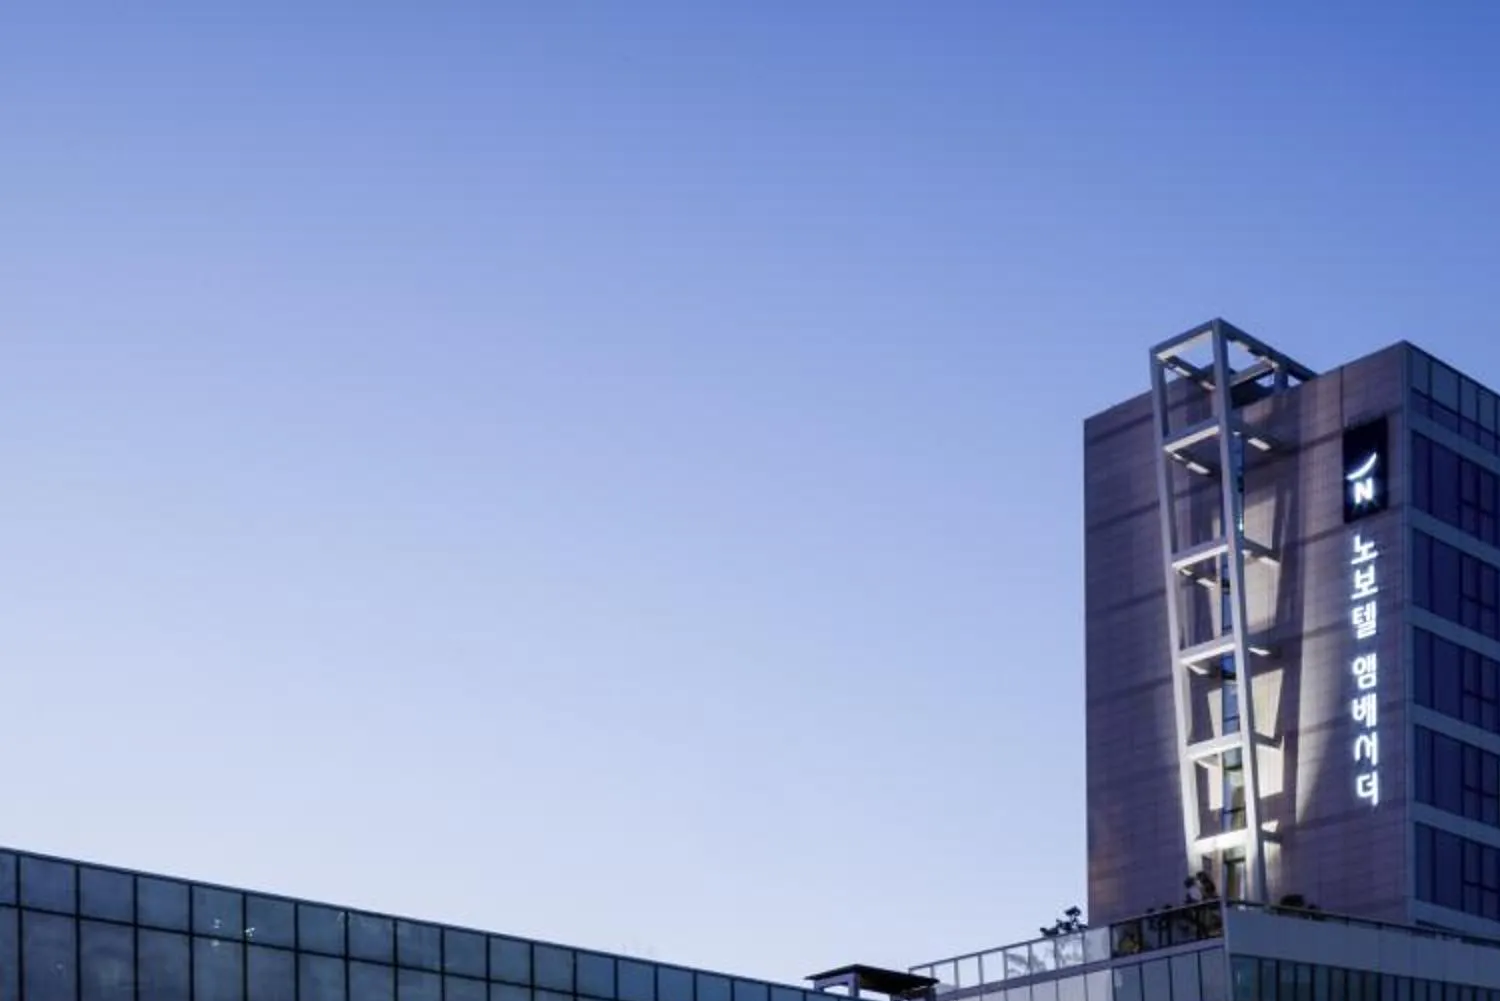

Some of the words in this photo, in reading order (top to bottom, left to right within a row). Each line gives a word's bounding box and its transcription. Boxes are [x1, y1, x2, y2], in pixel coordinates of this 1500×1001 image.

[1352, 477, 1373, 504] N
[1350, 534, 1379, 640] 노보텔
[1351, 652, 1379, 806] 앰배서더
